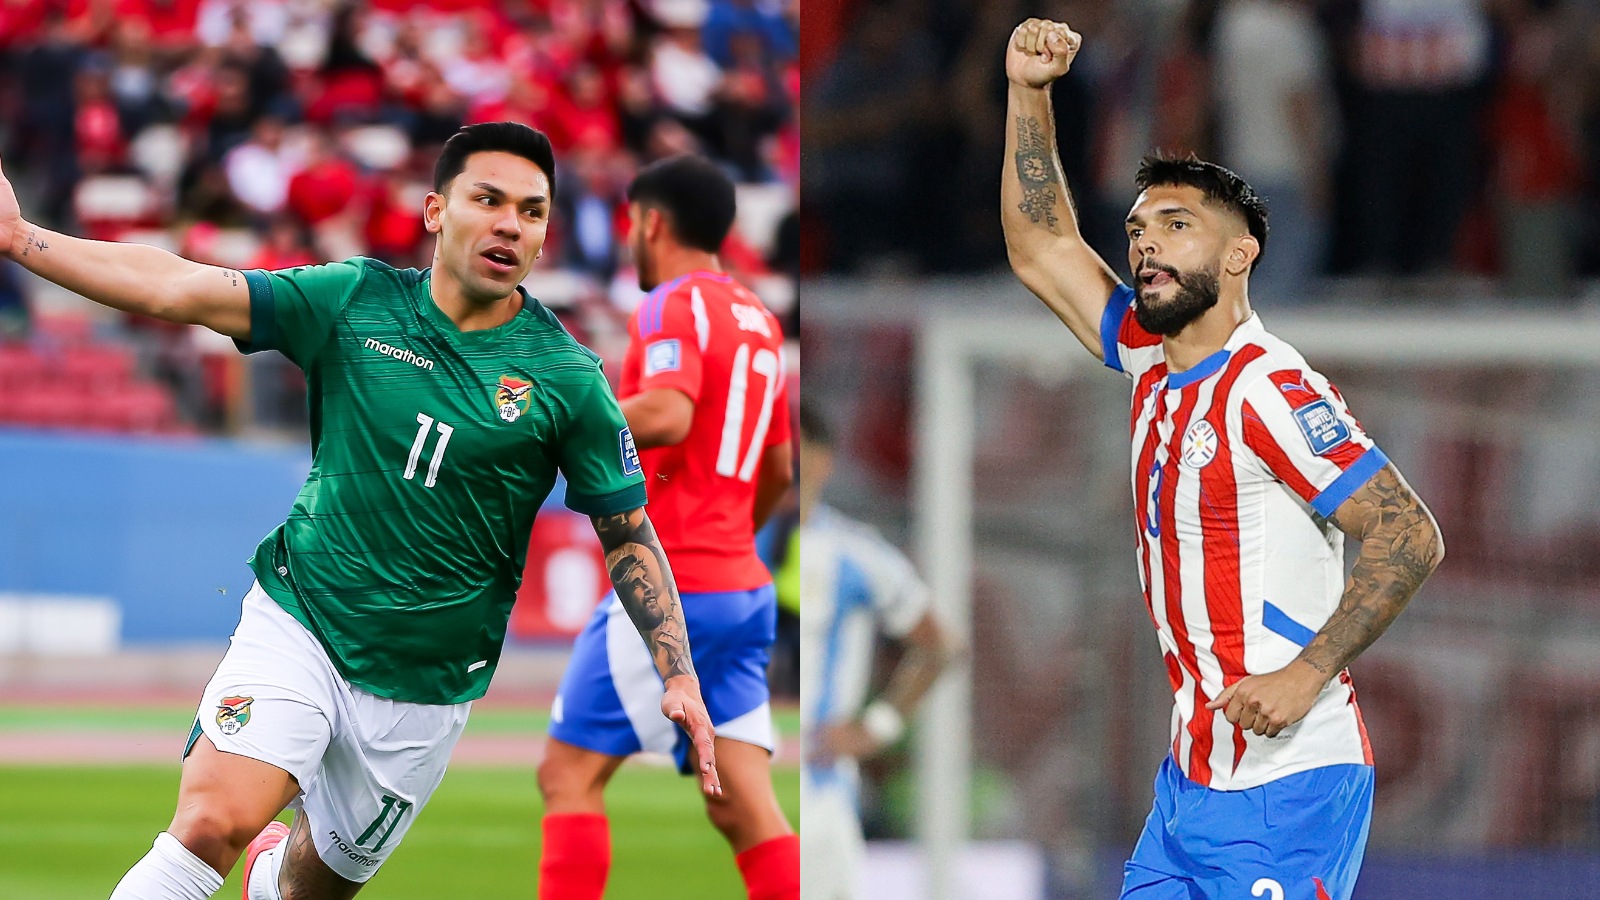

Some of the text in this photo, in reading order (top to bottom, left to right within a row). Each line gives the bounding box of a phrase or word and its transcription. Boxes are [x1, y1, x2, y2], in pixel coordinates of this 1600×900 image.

[364, 337, 435, 371] marathon
[715, 343, 778, 482] 17
[1307, 410, 1334, 430] UNITES
[402, 412, 455, 488] 11
[1146, 459, 1163, 538] 3
[329, 830, 379, 867] marathon
[354, 794, 413, 854] 11
